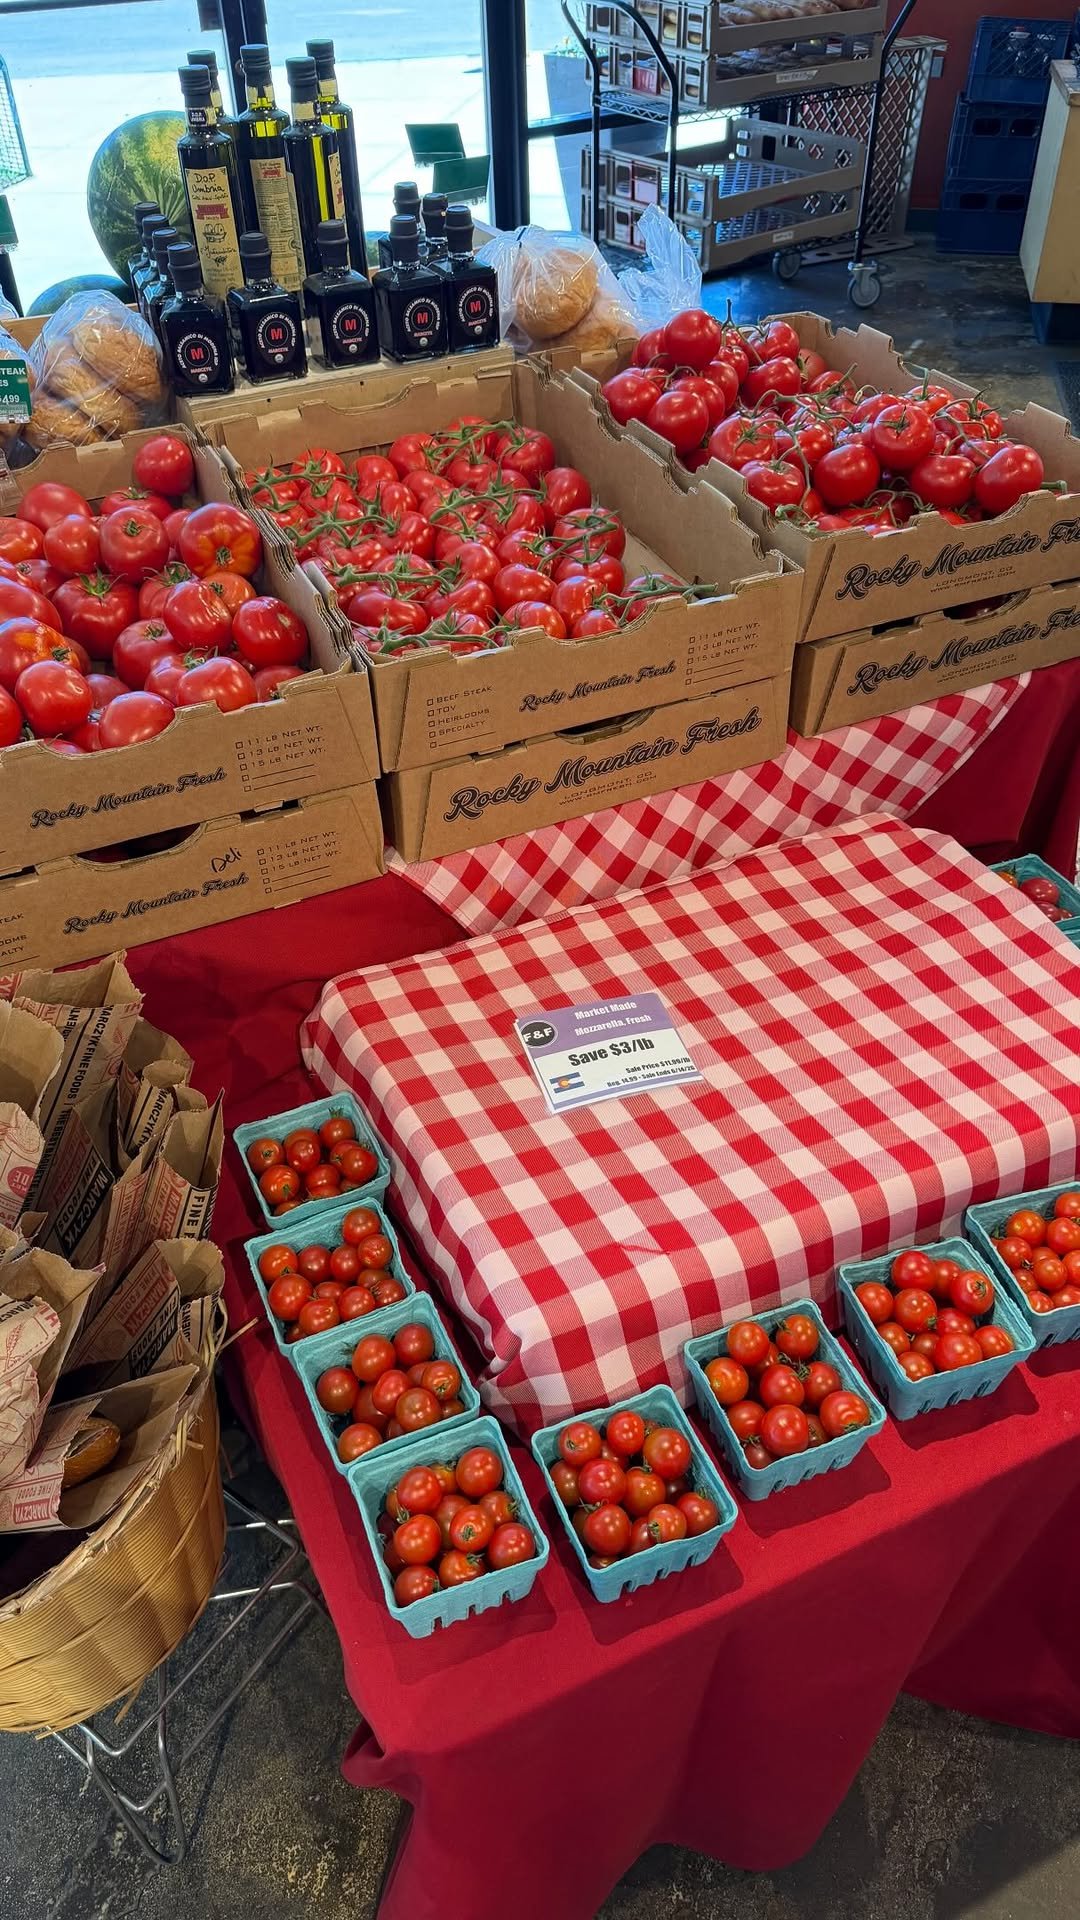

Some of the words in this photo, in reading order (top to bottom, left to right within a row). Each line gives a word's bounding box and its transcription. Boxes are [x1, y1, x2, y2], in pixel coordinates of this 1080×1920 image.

[470, 300, 481, 312] M
[345, 319, 356, 330] M
[417, 312, 428, 324] M
[270, 328, 283, 340] M
[190, 347, 204, 360] M
[835, 554, 922, 600] Rocky
[922, 531, 1041, 578] Mountain
[726, 626, 743, 635] NET
[725, 637, 741, 645] NET
[723, 647, 740, 656] NET
[847, 651, 928, 696] Rocky
[929, 623, 1040, 672] Mountain
[519, 688, 566, 712] Rocky
[568, 673, 634, 701] Mountain
[634, 659, 676, 684] Fresh
[436, 693, 459, 704] BEEF
[463, 685, 493, 697] STEAK
[436, 705, 456, 714] TOV
[438, 708, 490, 725] HEIRLOOMS
[282, 729, 302, 738] NET
[439, 720, 485, 736] SPECIALTY
[284, 741, 304, 749] NET
[286, 751, 305, 760] NET
[443, 774, 542, 823] Rocky
[544, 737, 680, 794] Mountain
[680, 706, 762, 755] Fresh
[30, 802, 89, 829] Rocky
[91, 783, 175, 814] Mountain
[176, 766, 228, 793] Fresh
[300, 835, 318, 844] NET
[302, 845, 320, 854] NET
[211, 847, 242, 873] Deli
[304, 855, 321, 863] NET
[63, 909, 118, 935] Rocky
[120, 889, 200, 919] Mountain
[200, 871, 249, 897] Fresh
[574, 1005, 609, 1020] Market
[610, 1001, 637, 1013] Made
[574, 1019, 626, 1036] Mozzarella,
[627, 1014, 652, 1025] Fresh
[522, 1027, 553, 1042] F&F
[79, 1047, 96, 1069] FINE
[568, 1048, 609, 1066] Save
[609, 1037, 655, 1057] $3/lb
[626, 1065, 641, 1074] Sale
[642, 1062, 660, 1071] Price
[656, 1068, 670, 1077] Ends
[67, 1069, 88, 1099] FOODS
[65, 1170, 109, 1249] MARCZYK
[161, 1190, 181, 1233] MARC
[187, 1196, 205, 1226] FINE
[15, 1502, 50, 1522] MARCZYK
